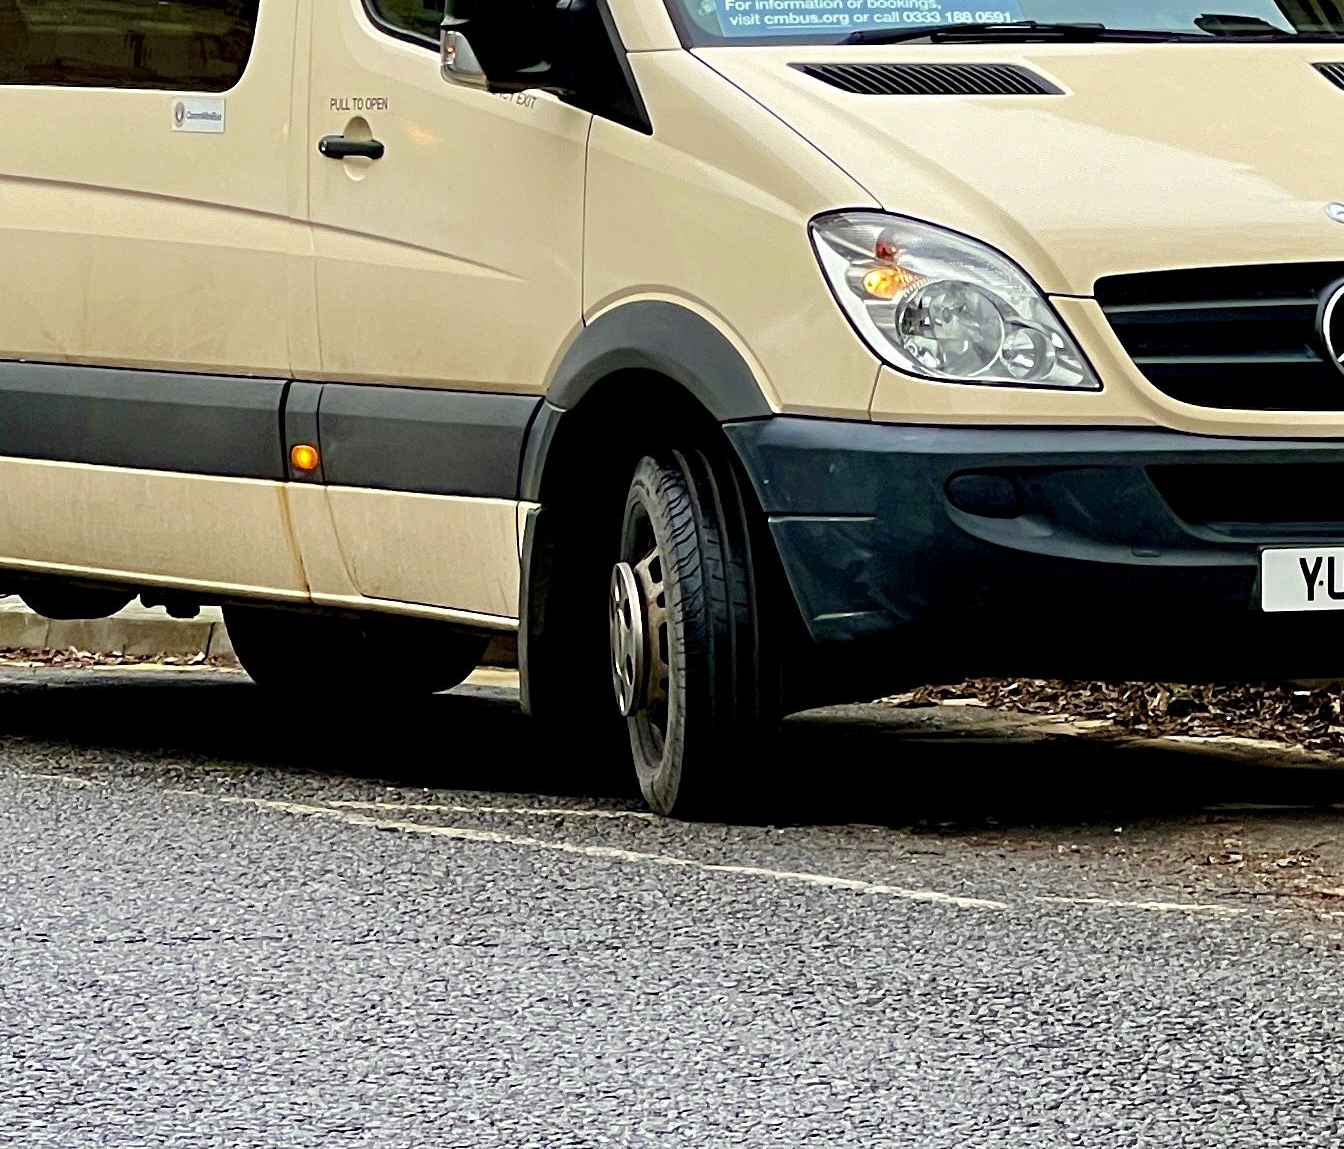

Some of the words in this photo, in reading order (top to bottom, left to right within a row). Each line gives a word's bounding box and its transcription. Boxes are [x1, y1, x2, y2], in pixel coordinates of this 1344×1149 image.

[725, 0, 751, 11] For
[730, 13, 760, 25] visit
[764, 13, 850, 26] cmbus.org
[855, 13, 872, 23] or
[873, 11, 900, 23] call
[902, 11, 941, 23] 0333
[945, 11, 973, 23] 188
[330, 98, 351, 110] PULL
[352, 98, 363, 110] TO
[365, 98, 388, 110] OPEN
